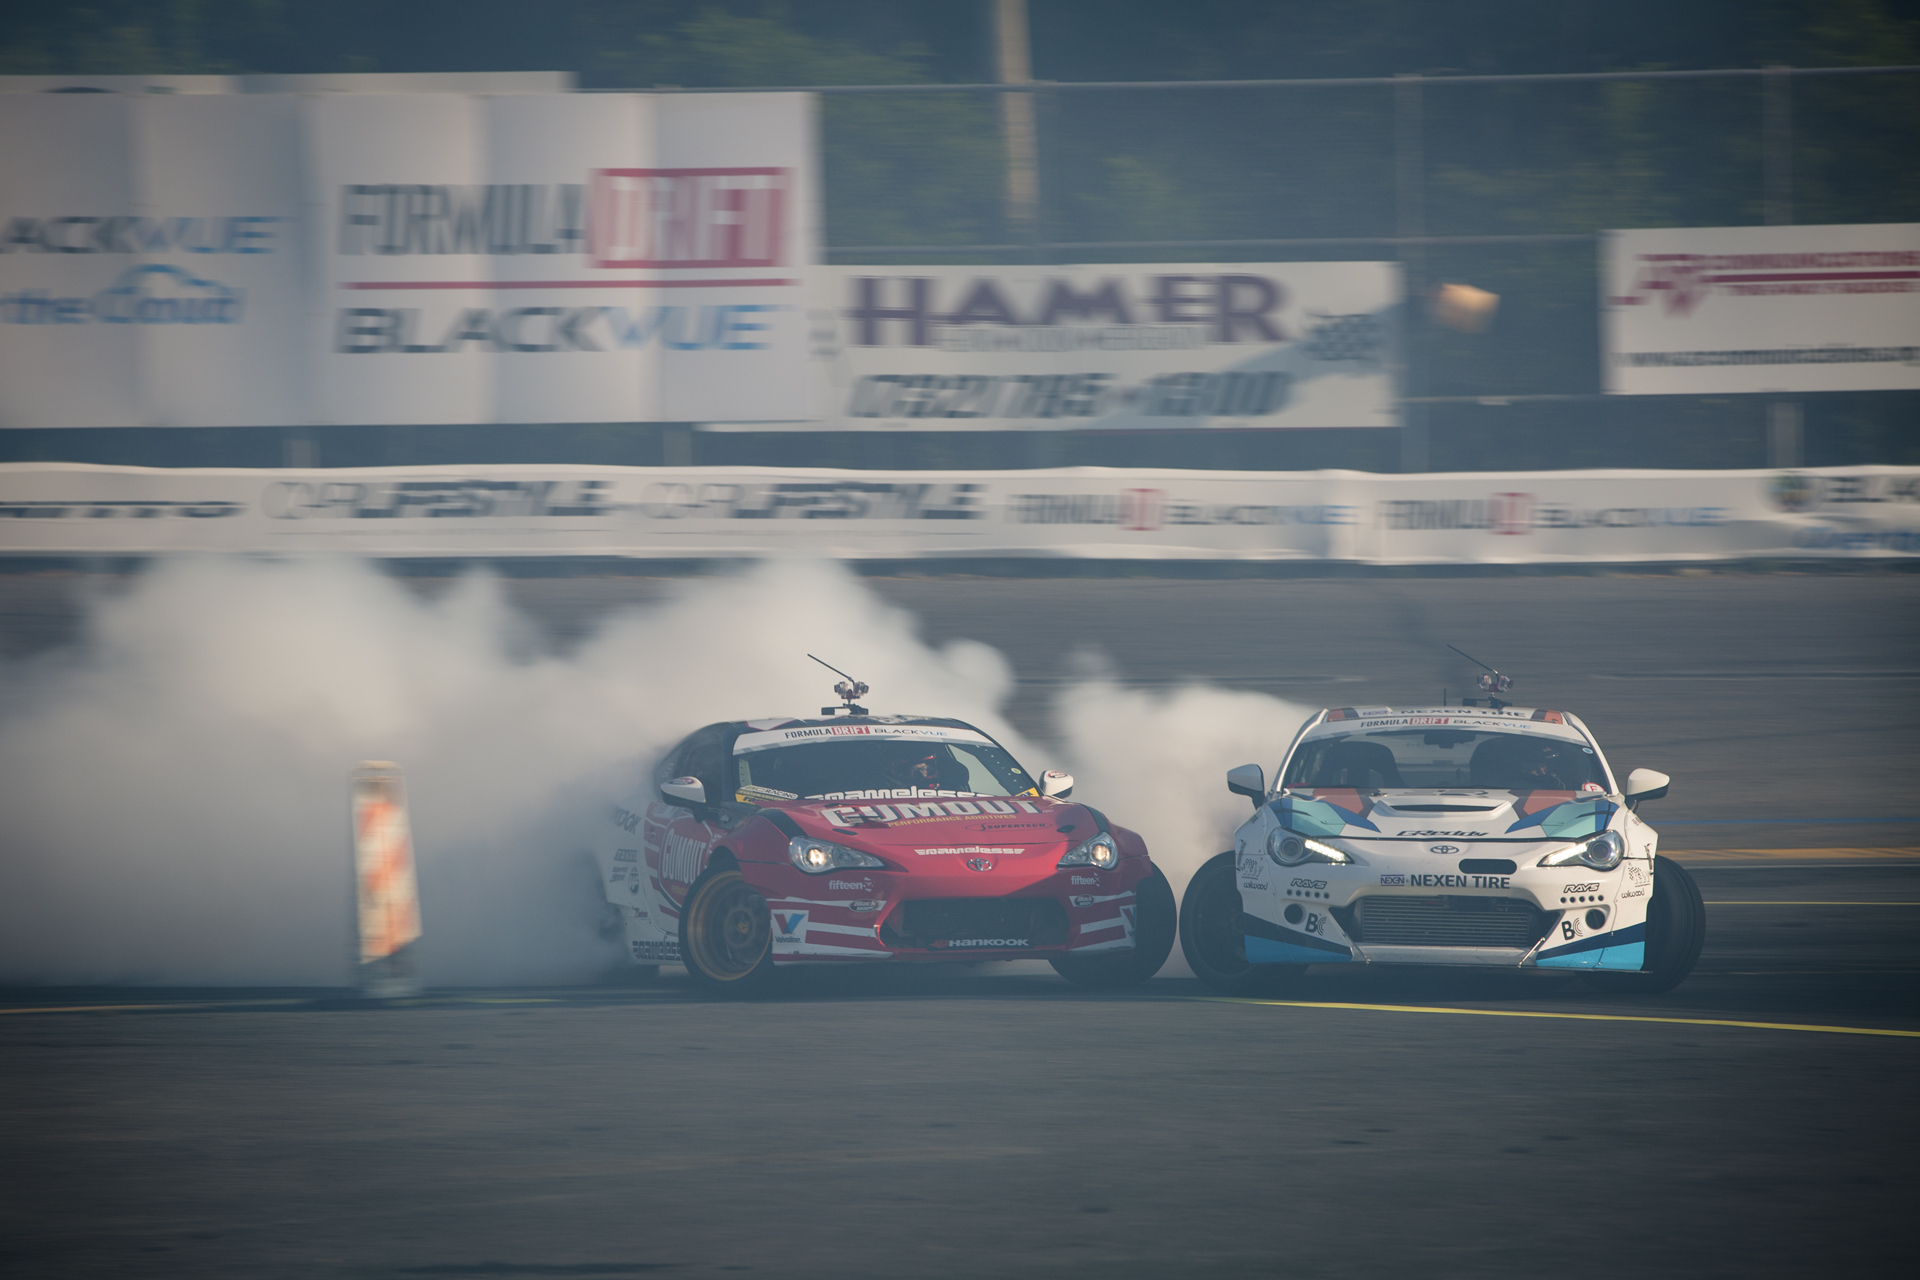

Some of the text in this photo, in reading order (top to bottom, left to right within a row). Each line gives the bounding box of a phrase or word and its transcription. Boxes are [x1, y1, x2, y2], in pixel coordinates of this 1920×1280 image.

[843, 274, 1290, 347] HAMER
[333, 304, 790, 353] BLACKVUE
[1360, 718, 1532, 729] FORMULA DRIFT BLACKVUE
[785, 726, 948, 739] FORMULA DRIFT BLACKVUE
[820, 800, 1042, 828] GUMOUT
[888, 814, 1017, 827] PERFORMANCE ADDITIVES
[662, 828, 707, 885] GUMOUT
[1291, 878, 1328, 889] RAYS
[1410, 874, 1467, 887] NEXEN
[1472, 876, 1511, 889] TIRE
[1563, 882, 1600, 893] RAYS
